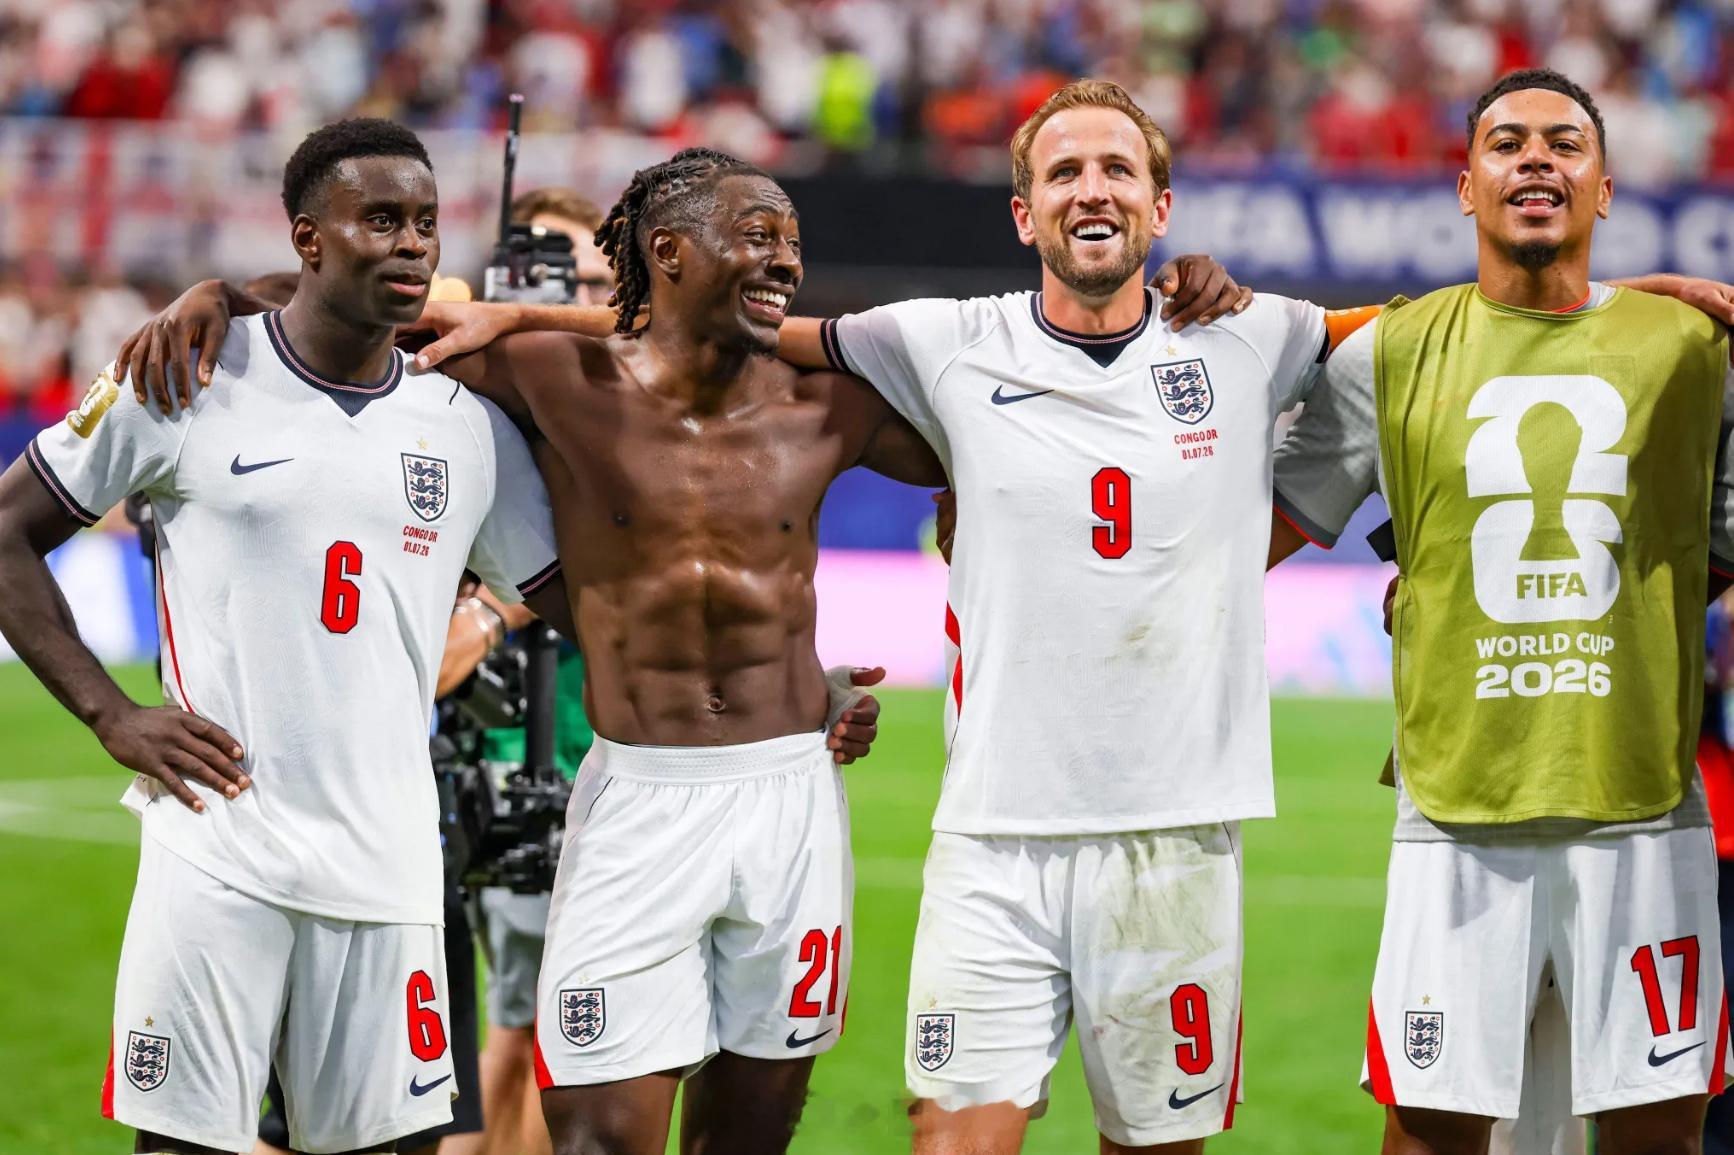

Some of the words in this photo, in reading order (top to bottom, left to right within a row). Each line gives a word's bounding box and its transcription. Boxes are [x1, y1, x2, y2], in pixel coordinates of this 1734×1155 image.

[1174, 430, 1206, 445] CONGO
[1206, 428, 1218, 441] DR
[1182, 445, 1214, 460] 01.07.26
[1091, 467, 1132, 559] 9
[403, 525, 428, 541] CONGO
[428, 531, 438, 543] DR
[403, 541, 430, 557] 01.07.26
[321, 540, 363, 634] 6
[1516, 572, 1588, 600] FIFA
[1475, 632, 1571, 659] WORLD
[1575, 631, 1615, 657] CUP
[1475, 658, 1612, 699] 2026
[788, 925, 842, 1018] 21
[1631, 935, 1700, 1037] 17
[407, 969, 447, 1062] 6
[1169, 983, 1213, 1075] 9
